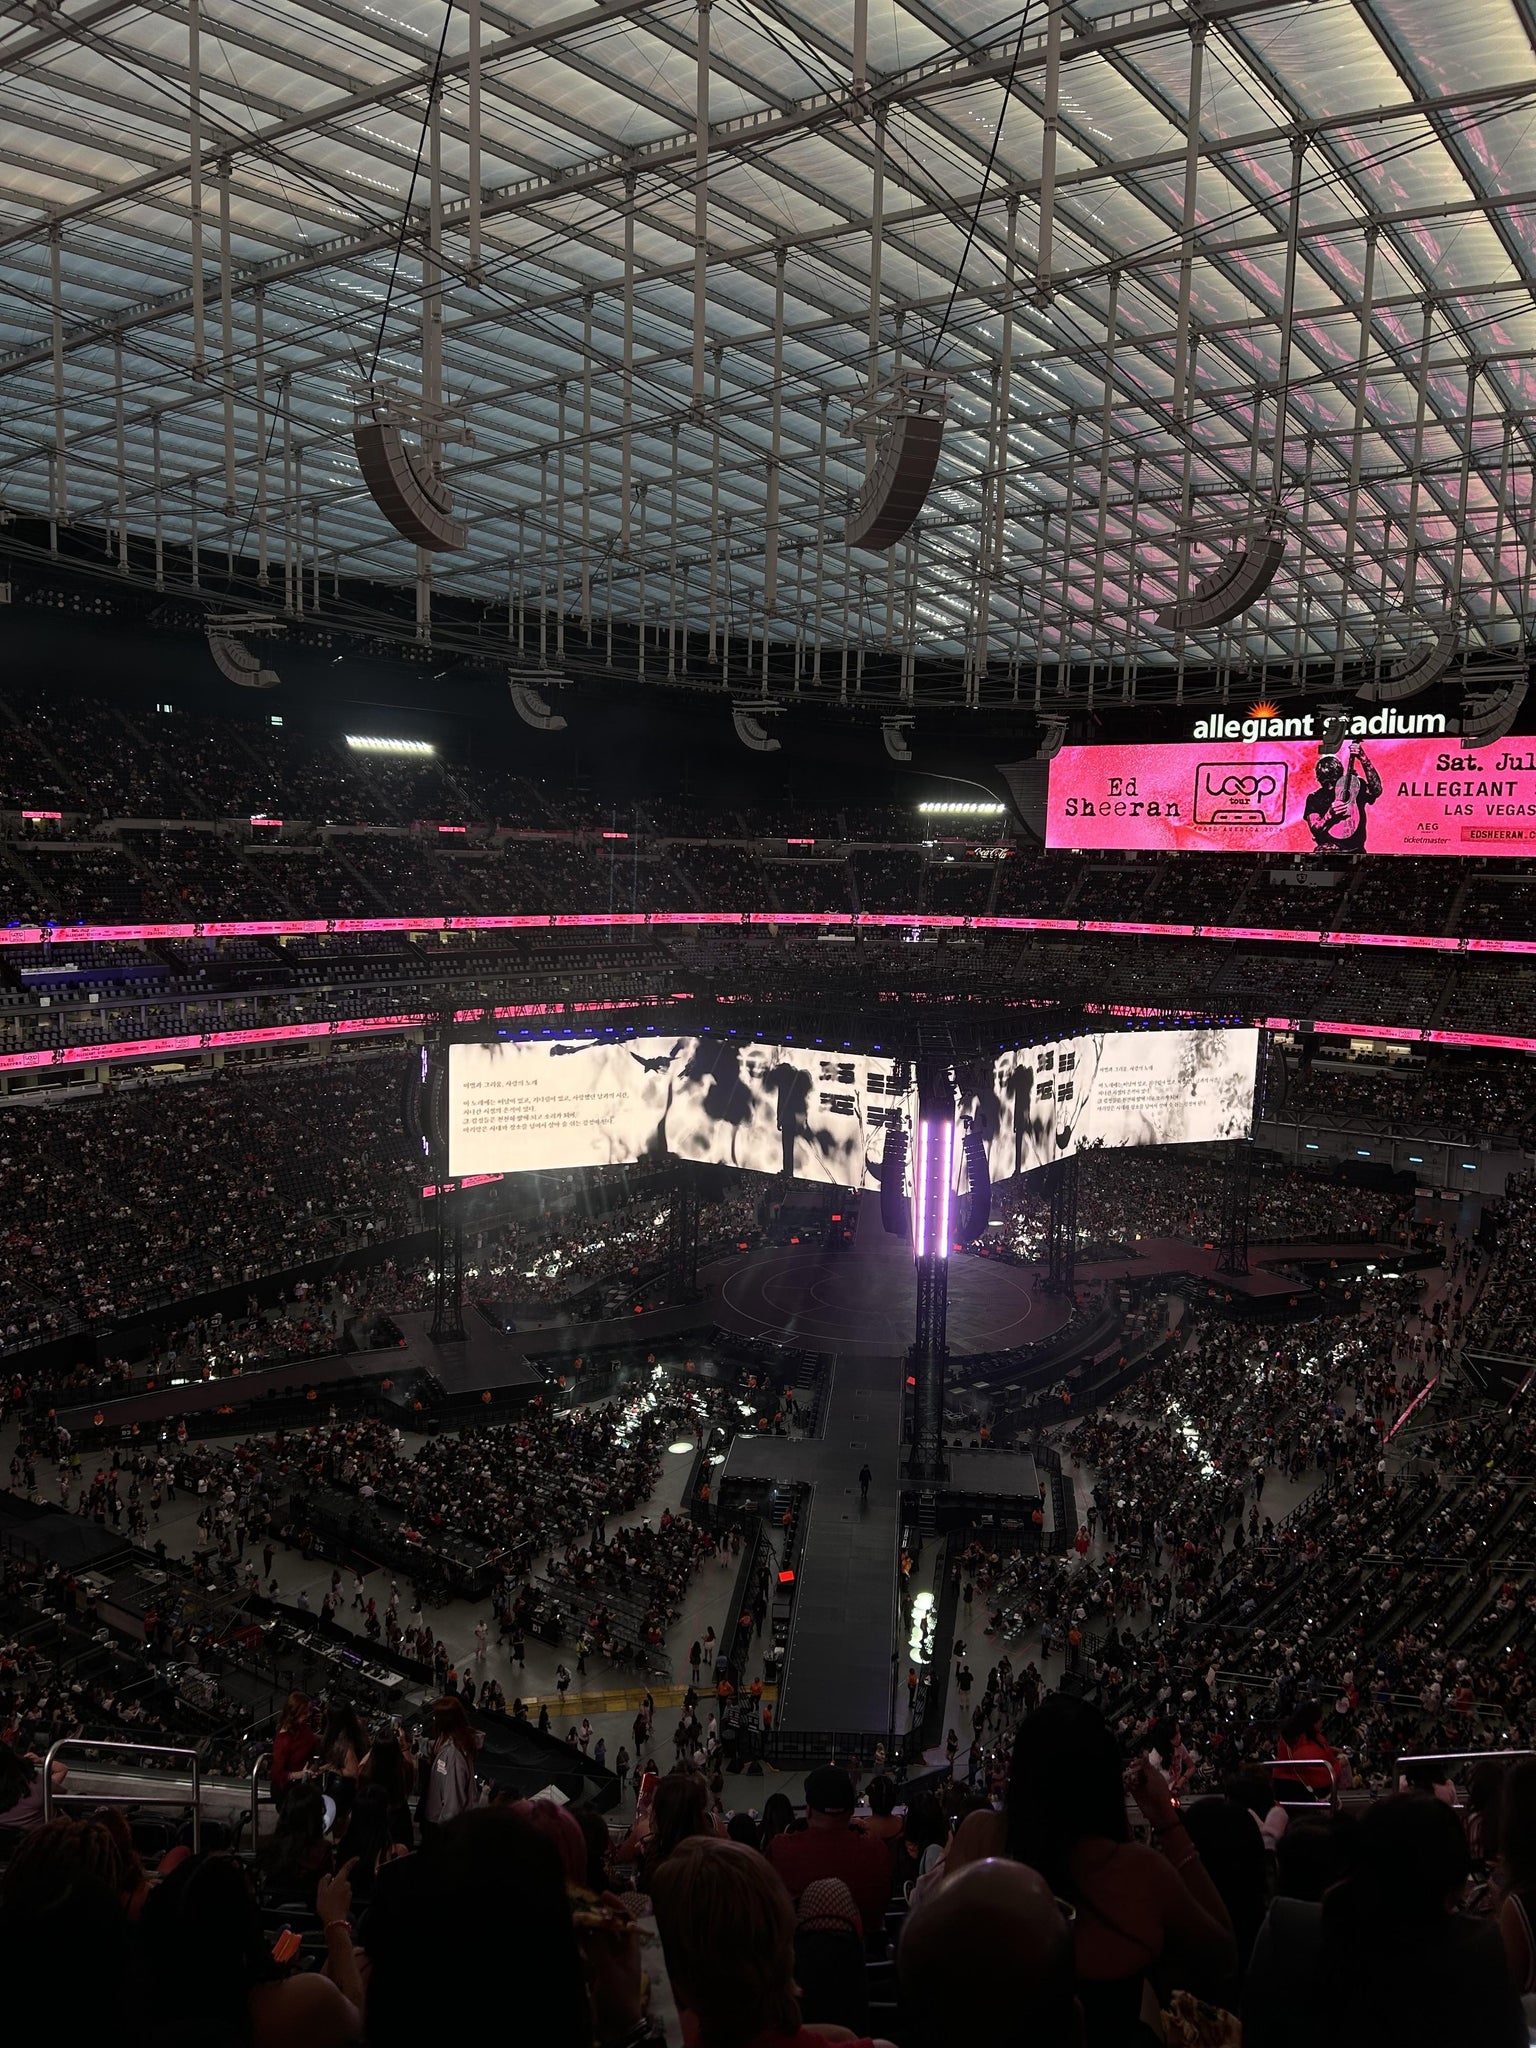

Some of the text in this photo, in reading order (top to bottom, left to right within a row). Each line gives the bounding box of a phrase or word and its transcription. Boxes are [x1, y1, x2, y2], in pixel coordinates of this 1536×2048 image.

[1193, 714, 1314, 744] allegiant
[1436, 753, 1484, 771] Sat.
[1107, 777, 1139, 797] Ed
[1397, 781, 1518, 797] ALLEGIANT
[1065, 797, 1181, 817] Sheeran
[1229, 797, 1251, 805] tour
[1444, 804, 1536, 816] LAS VEGAS
[1417, 822, 1439, 831] AEG
[1403, 836, 1449, 844] ticketmaster
[532, 1623, 542, 1635] D1
